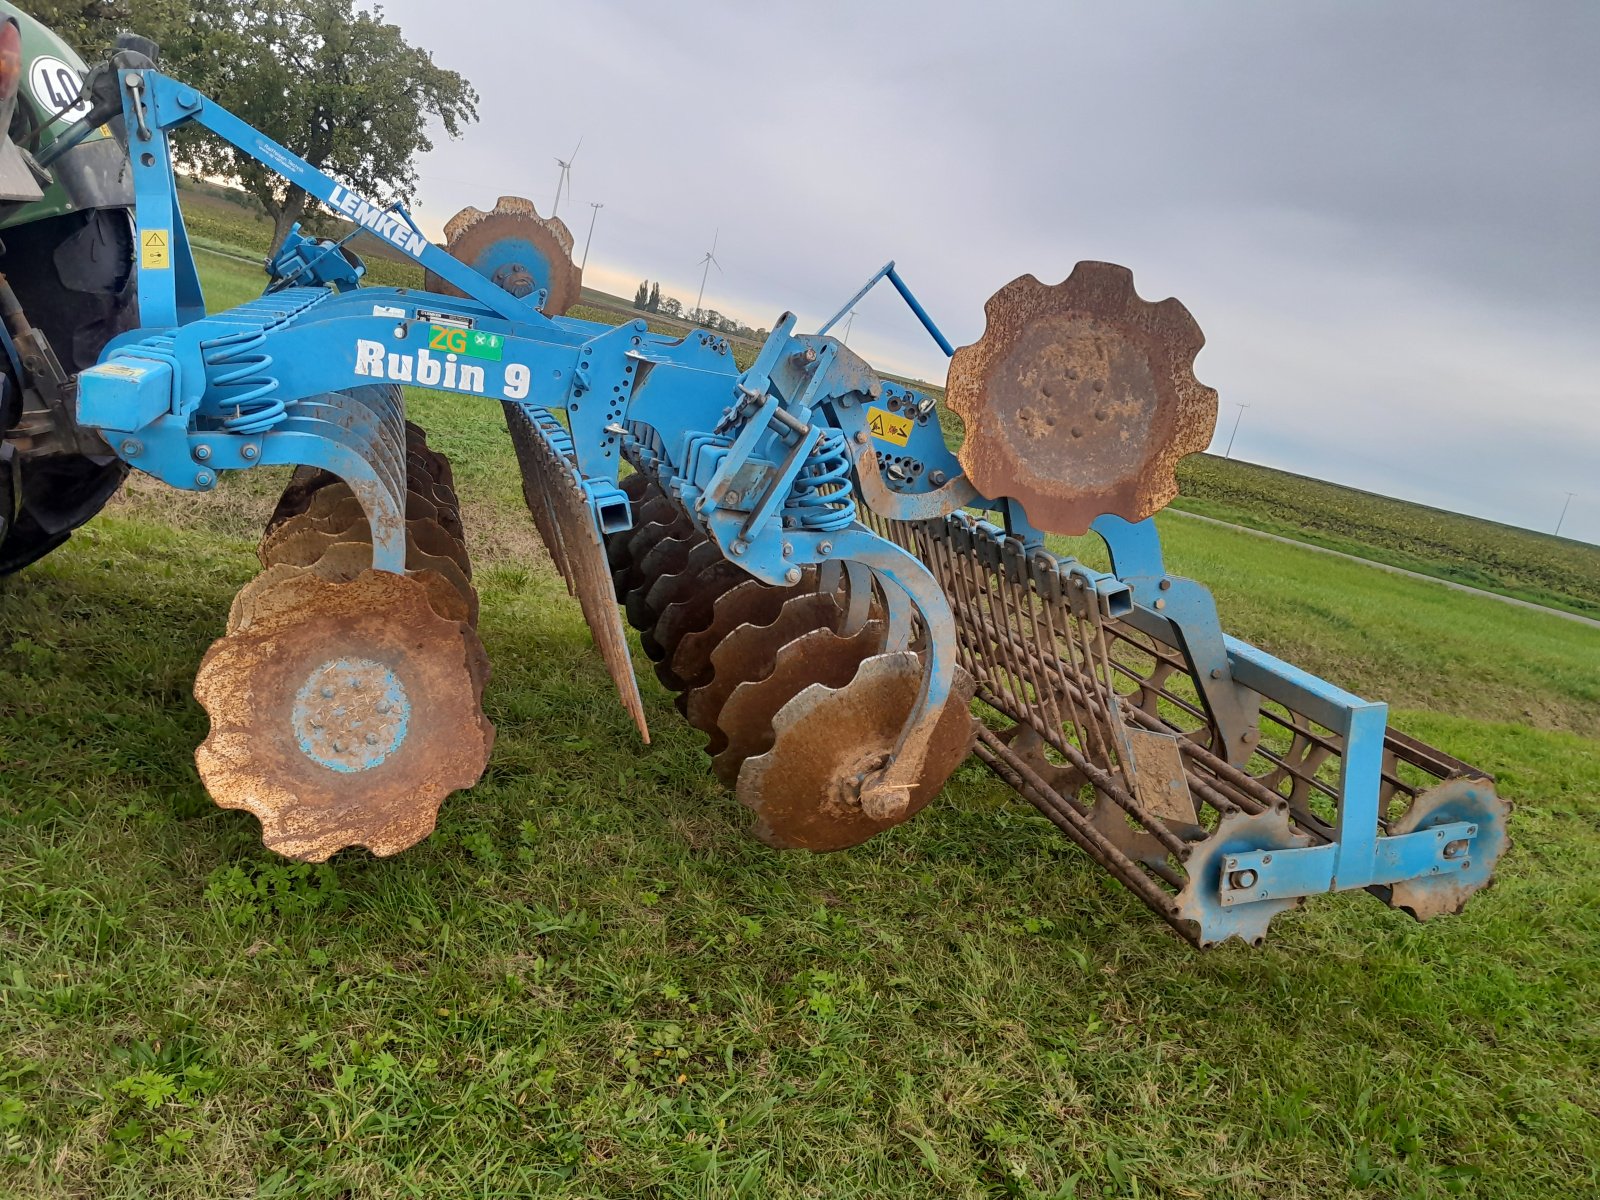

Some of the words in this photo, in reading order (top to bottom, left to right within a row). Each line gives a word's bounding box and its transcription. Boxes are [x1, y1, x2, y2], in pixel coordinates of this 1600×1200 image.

[41, 68, 86, 112] 40
[328, 184, 428, 258] LEMKEN
[429, 325, 468, 354] ZG
[354, 338, 485, 393] Rubin
[503, 363, 531, 399] 9
